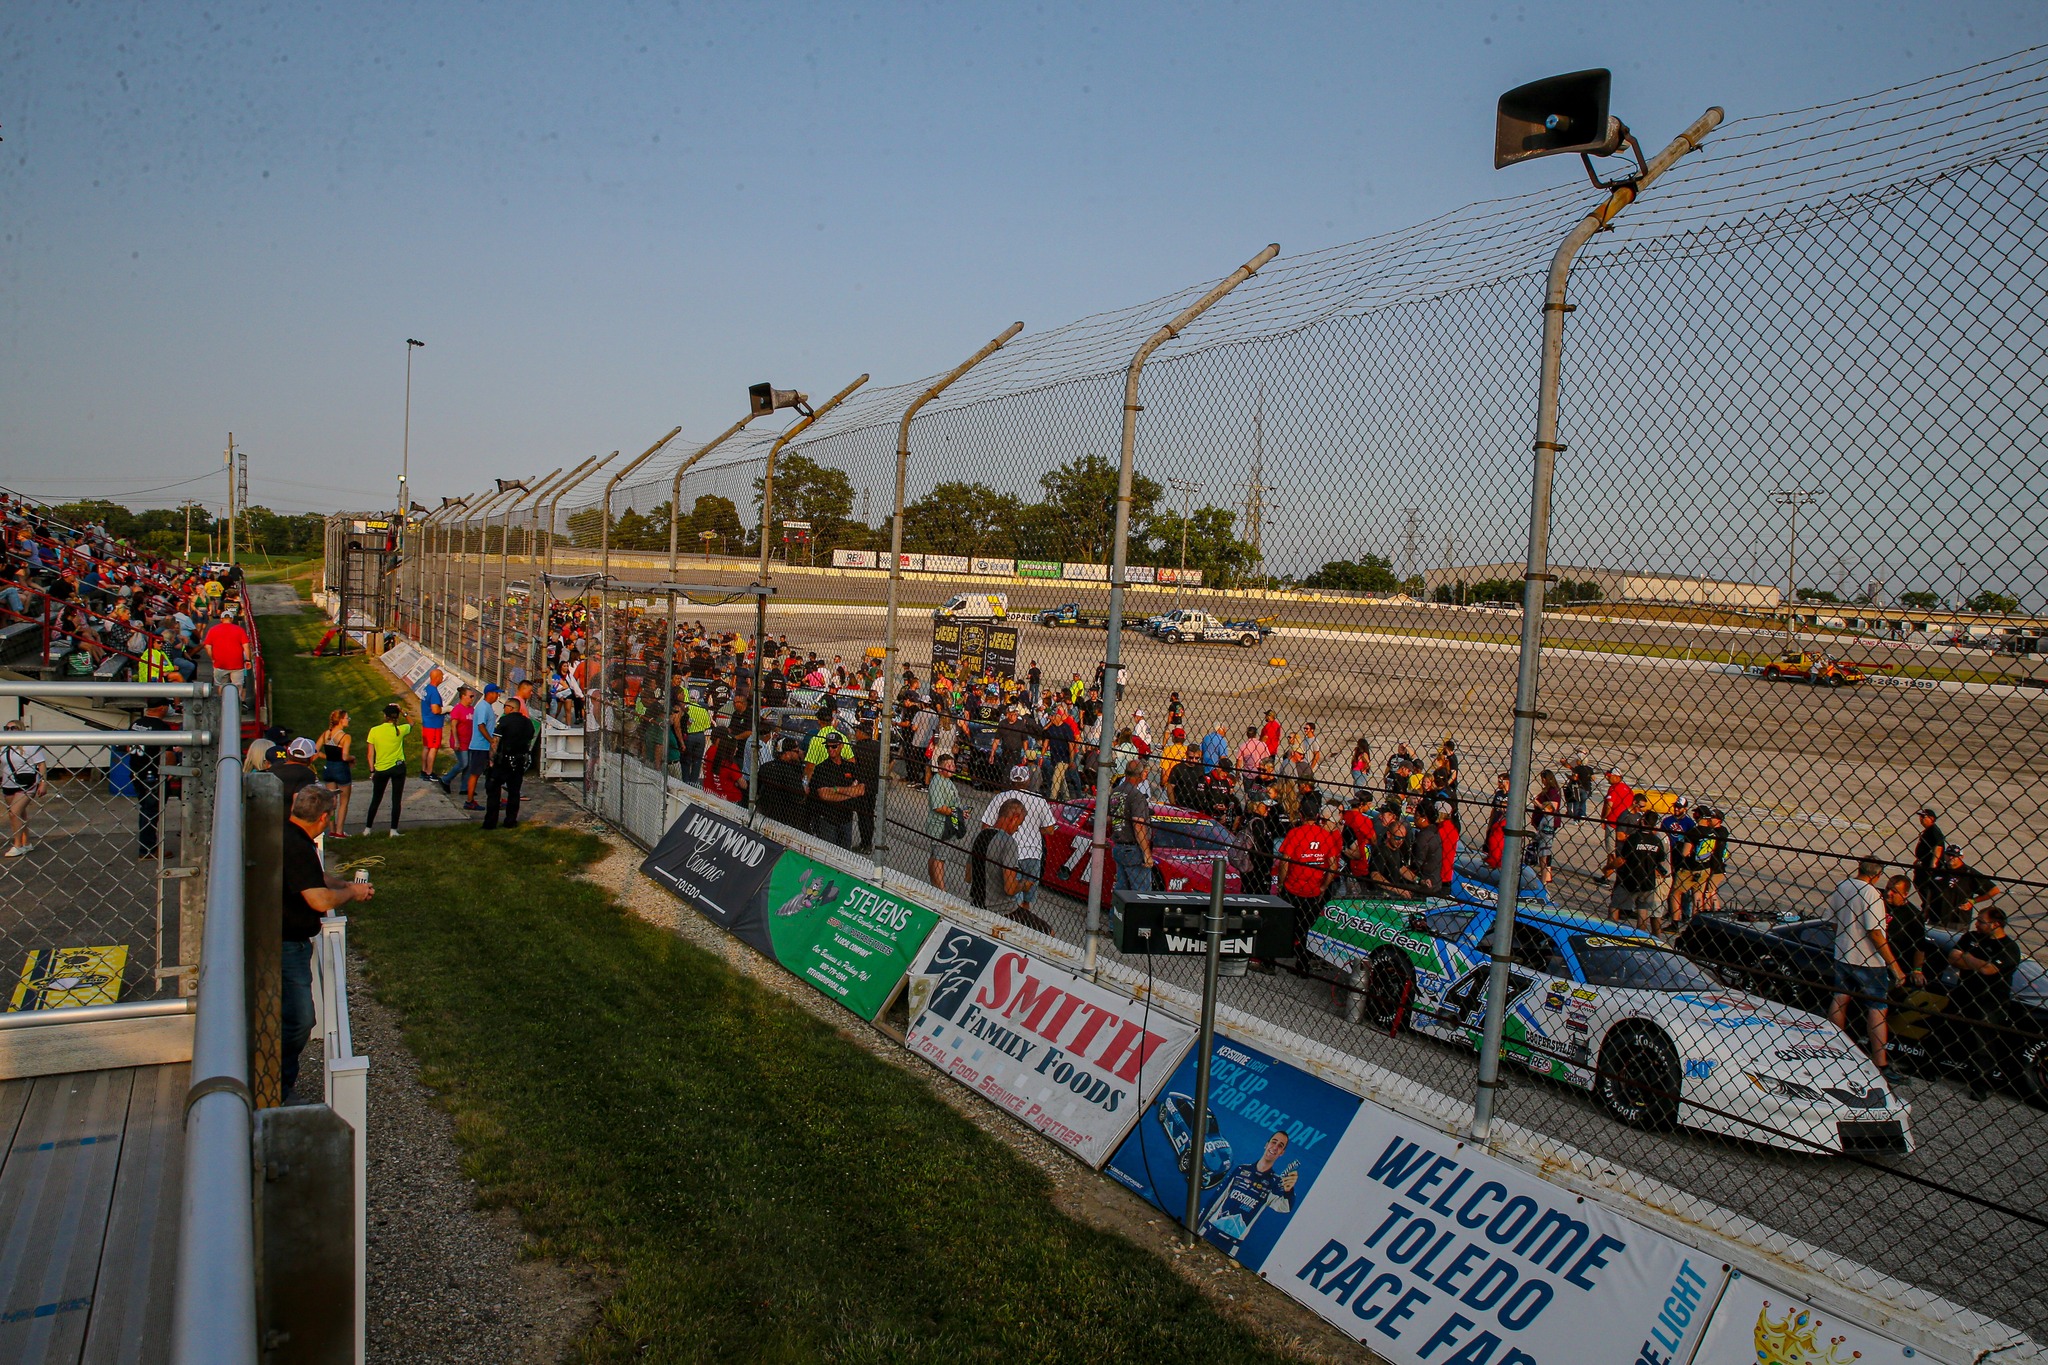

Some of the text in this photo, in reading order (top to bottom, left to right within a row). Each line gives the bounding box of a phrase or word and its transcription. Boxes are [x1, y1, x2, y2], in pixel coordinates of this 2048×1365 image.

[1004, 612, 1040, 621] ROPANE
[684, 813, 766, 867] HOLLYWOOD
[676, 878, 700, 899] TOLEDO
[843, 886, 912, 931] STEVENS
[1165, 934, 1253, 954] WHEEN
[1324, 906, 1384, 937] Crystal
[1379, 926, 1431, 956] Clean
[975, 952, 1168, 1085] SMITH
[916, 1034, 947, 1064] TOTAL
[947, 1056, 980, 1083] FOOD
[977, 1075, 1026, 1112] SERVICE
[956, 1003, 1037, 1063] FAMILY
[1034, 1046, 1126, 1113] FOODS
[1216, 1045, 1270, 1075] KEYSTONE LIGHT
[1240, 1072, 1269, 1096] UP
[1209, 1083, 1243, 1112] FOR
[1238, 1098, 1289, 1134] RACE
[1285, 1118, 1328, 1151] DAY
[1230, 1189, 1259, 1209] KEYSTONE
[1366, 1135, 1626, 1291] WELCOME
[1363, 1201, 1554, 1331] TOLEDO
[1296, 1238, 1538, 1365] RACE FA
[1650, 1258, 1708, 1355] LIGHT
